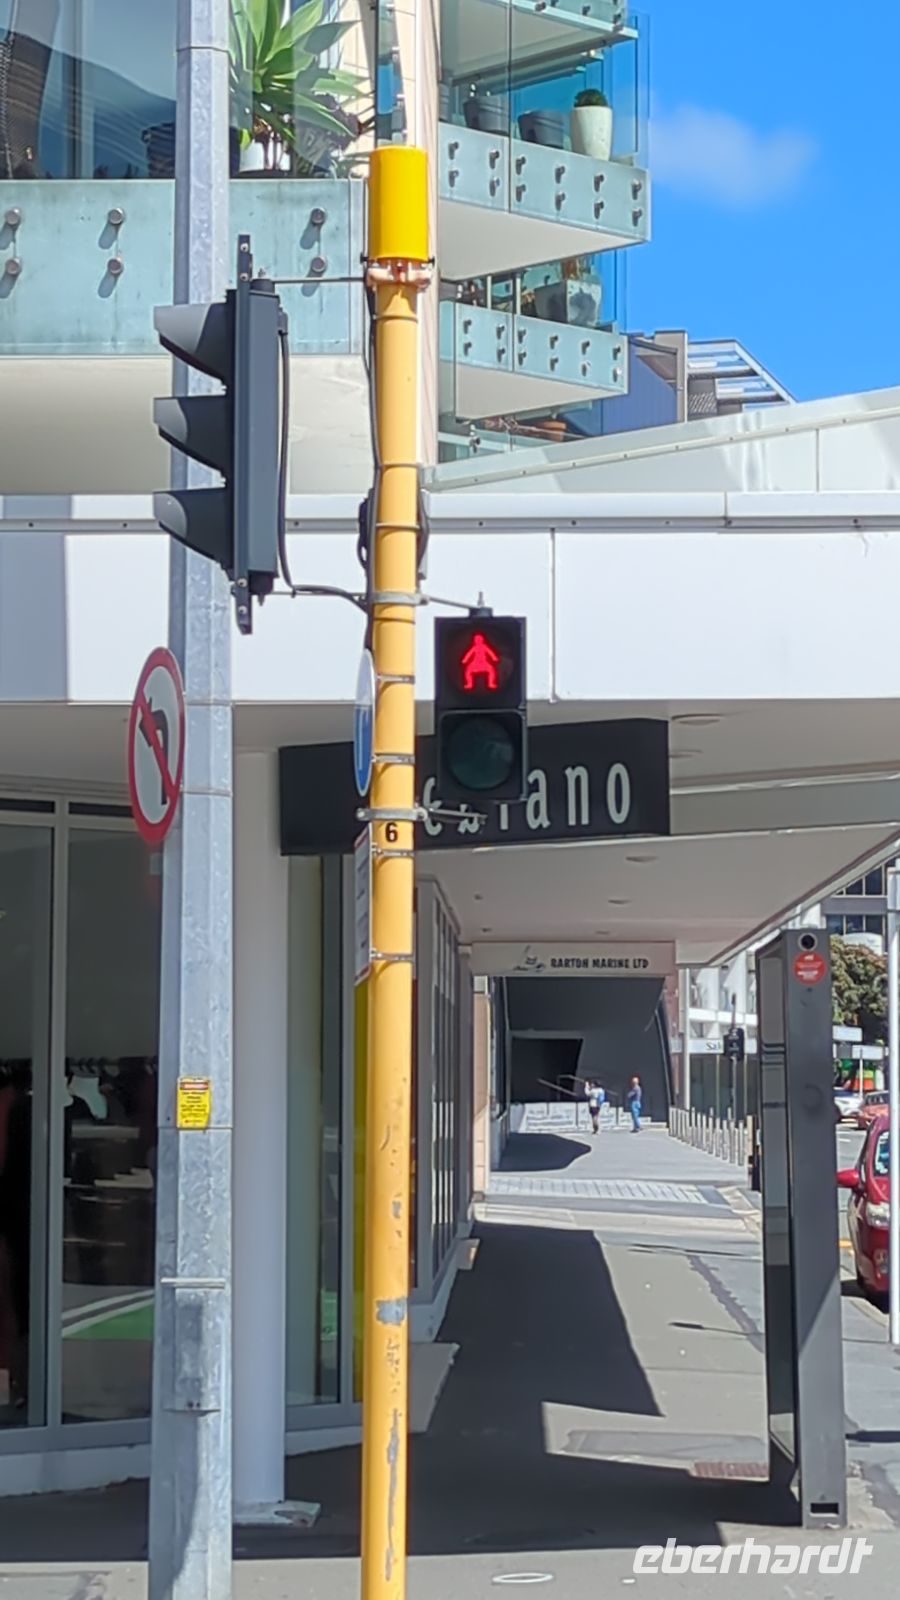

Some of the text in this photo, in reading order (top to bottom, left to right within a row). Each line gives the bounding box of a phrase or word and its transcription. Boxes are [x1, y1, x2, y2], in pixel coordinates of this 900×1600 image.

[423, 762, 631, 836] eano
[384, 821, 399, 843] 6
[592, 958, 629, 968] MARINE
[633, 958, 649, 968] LTD
